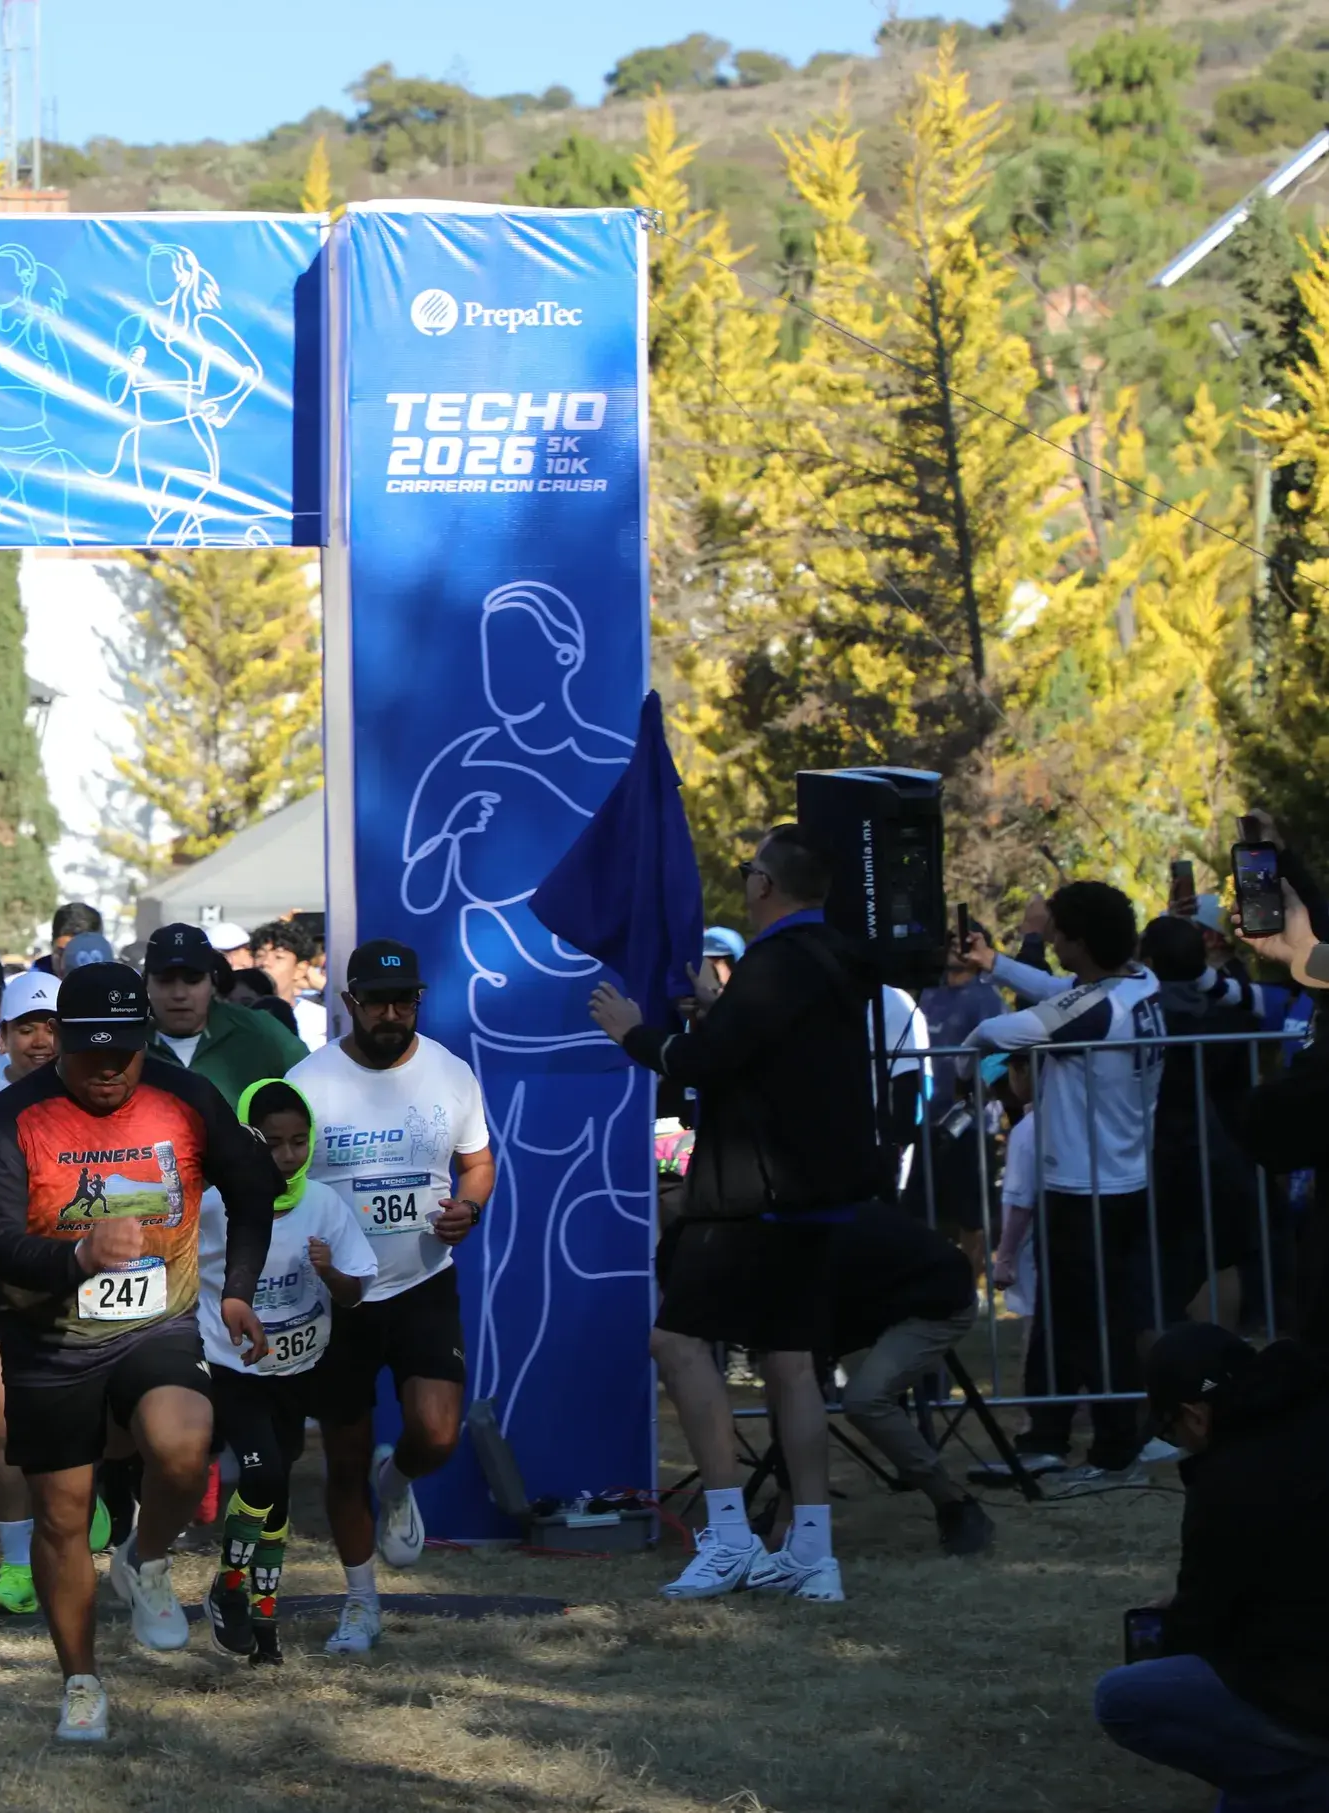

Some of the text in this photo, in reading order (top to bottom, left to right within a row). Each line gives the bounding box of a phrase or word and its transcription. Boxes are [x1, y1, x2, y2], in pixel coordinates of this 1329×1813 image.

[463, 301, 583, 333] PrepaTec
[385, 392, 608, 432] TECHO
[546, 436, 581, 453] 5K
[386, 436, 537, 475] 2026
[546, 457, 590, 475] 10K
[385, 479, 608, 493] CARRERA CON CAUSA
[324, 1129, 404, 1149] TECHO
[57, 1146, 155, 1165] RUNNERS
[326, 1145, 378, 1162] 2026
[372, 1192, 418, 1225] 364
[99, 1275, 150, 1309] 247
[255, 1272, 298, 1293] CHO
[275, 1324, 317, 1361] 362
